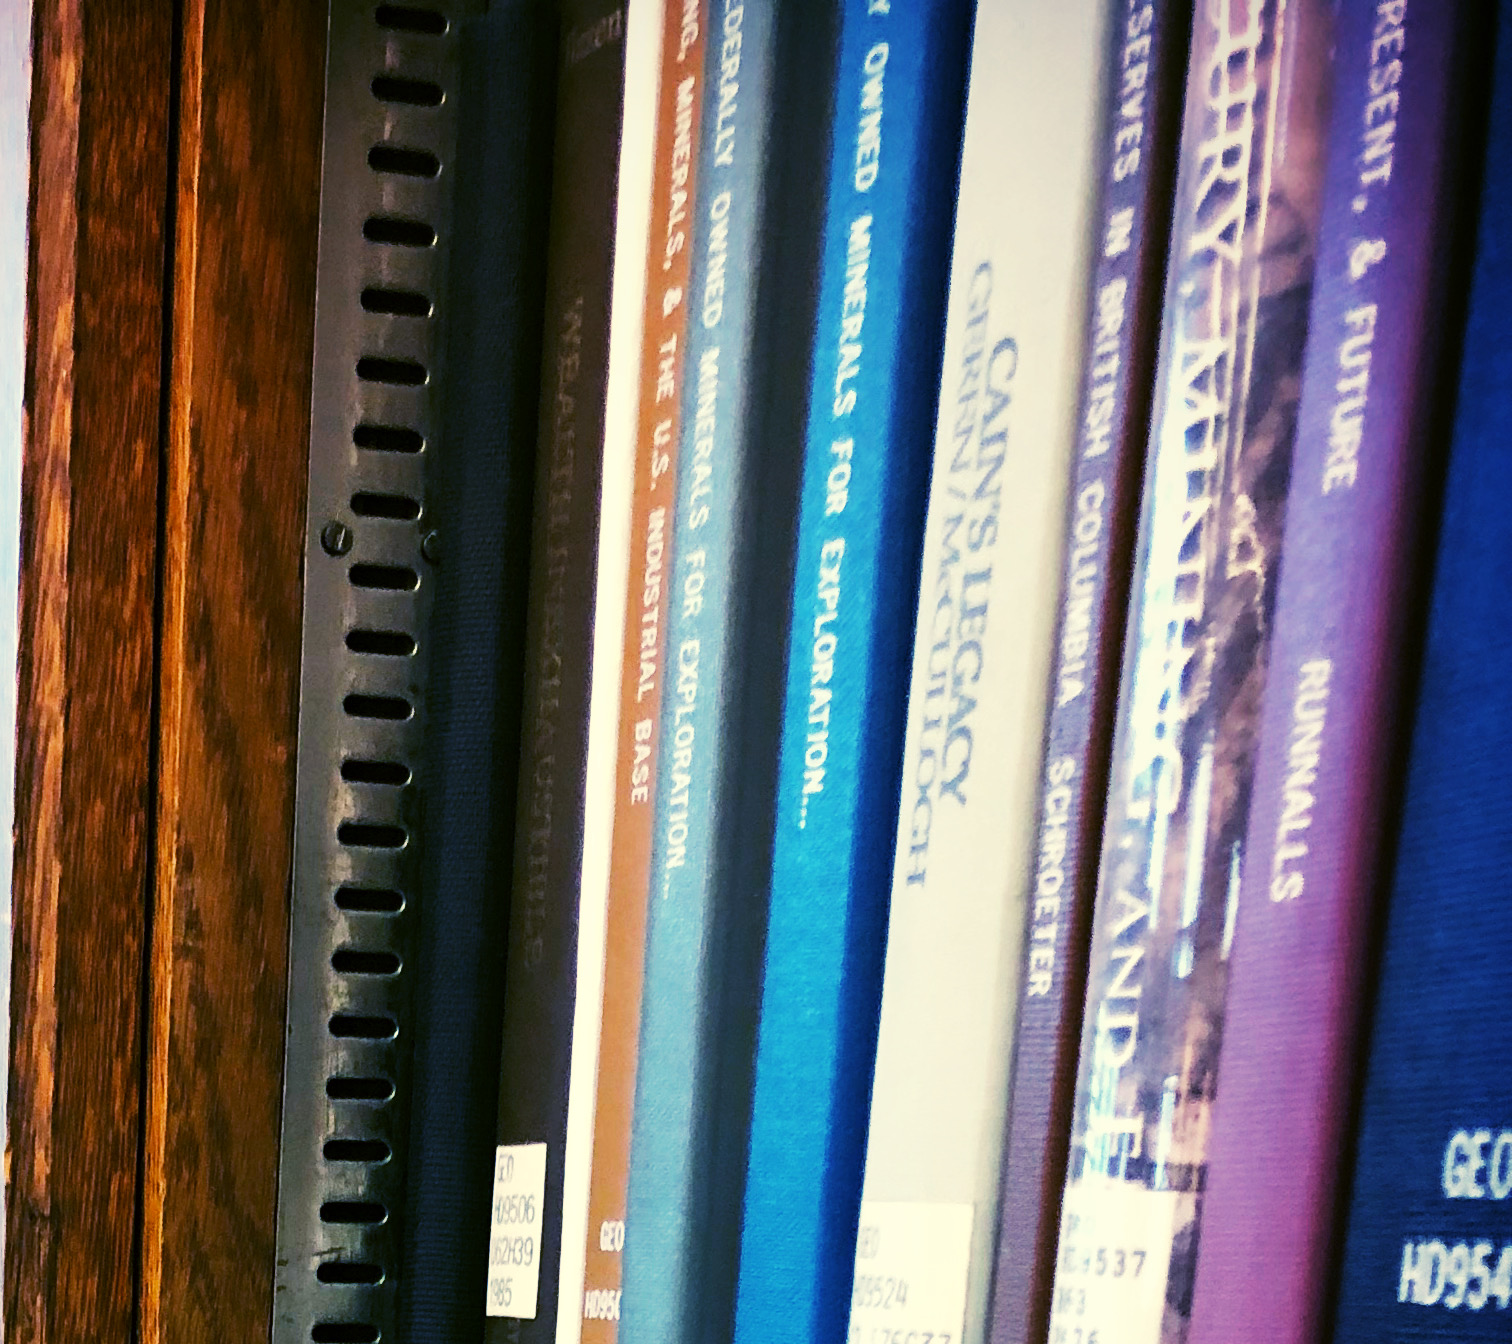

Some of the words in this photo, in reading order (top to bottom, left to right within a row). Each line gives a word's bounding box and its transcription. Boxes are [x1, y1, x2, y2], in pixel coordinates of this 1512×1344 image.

[715, 0, 745, 167] DERALLY
[854, 41, 889, 193] OWNED
[663, 286, 683, 318] &
[702, 191, 732, 330] OWNED
[1104, 205, 1135, 258] IN
[1347, 237, 1388, 282] &
[656, 333, 678, 404] THE
[832, 214, 873, 418] MINERALS
[1081, 277, 1127, 458] BRITISH
[648, 419, 672, 495] U.S.
[688, 347, 720, 531] MINERALS
[964, 336, 1019, 554] CAIN'S
[1320, 303, 1379, 497] FUTURE
[823, 436, 855, 517] FOR
[637, 506, 666, 700] INDUSTRIAL
[682, 547, 707, 620] FOR
[1055, 479, 1105, 707] COLUMBIA
[937, 565, 992, 806] LEGACY
[631, 718, 652, 806] BASE
[1270, 656, 1332, 903] RUNNALLS
[1028, 755, 1077, 997] SCHROETER
[599, 1220, 626, 1253] GEO
[1440, 1129, 1512, 1200] GEO
